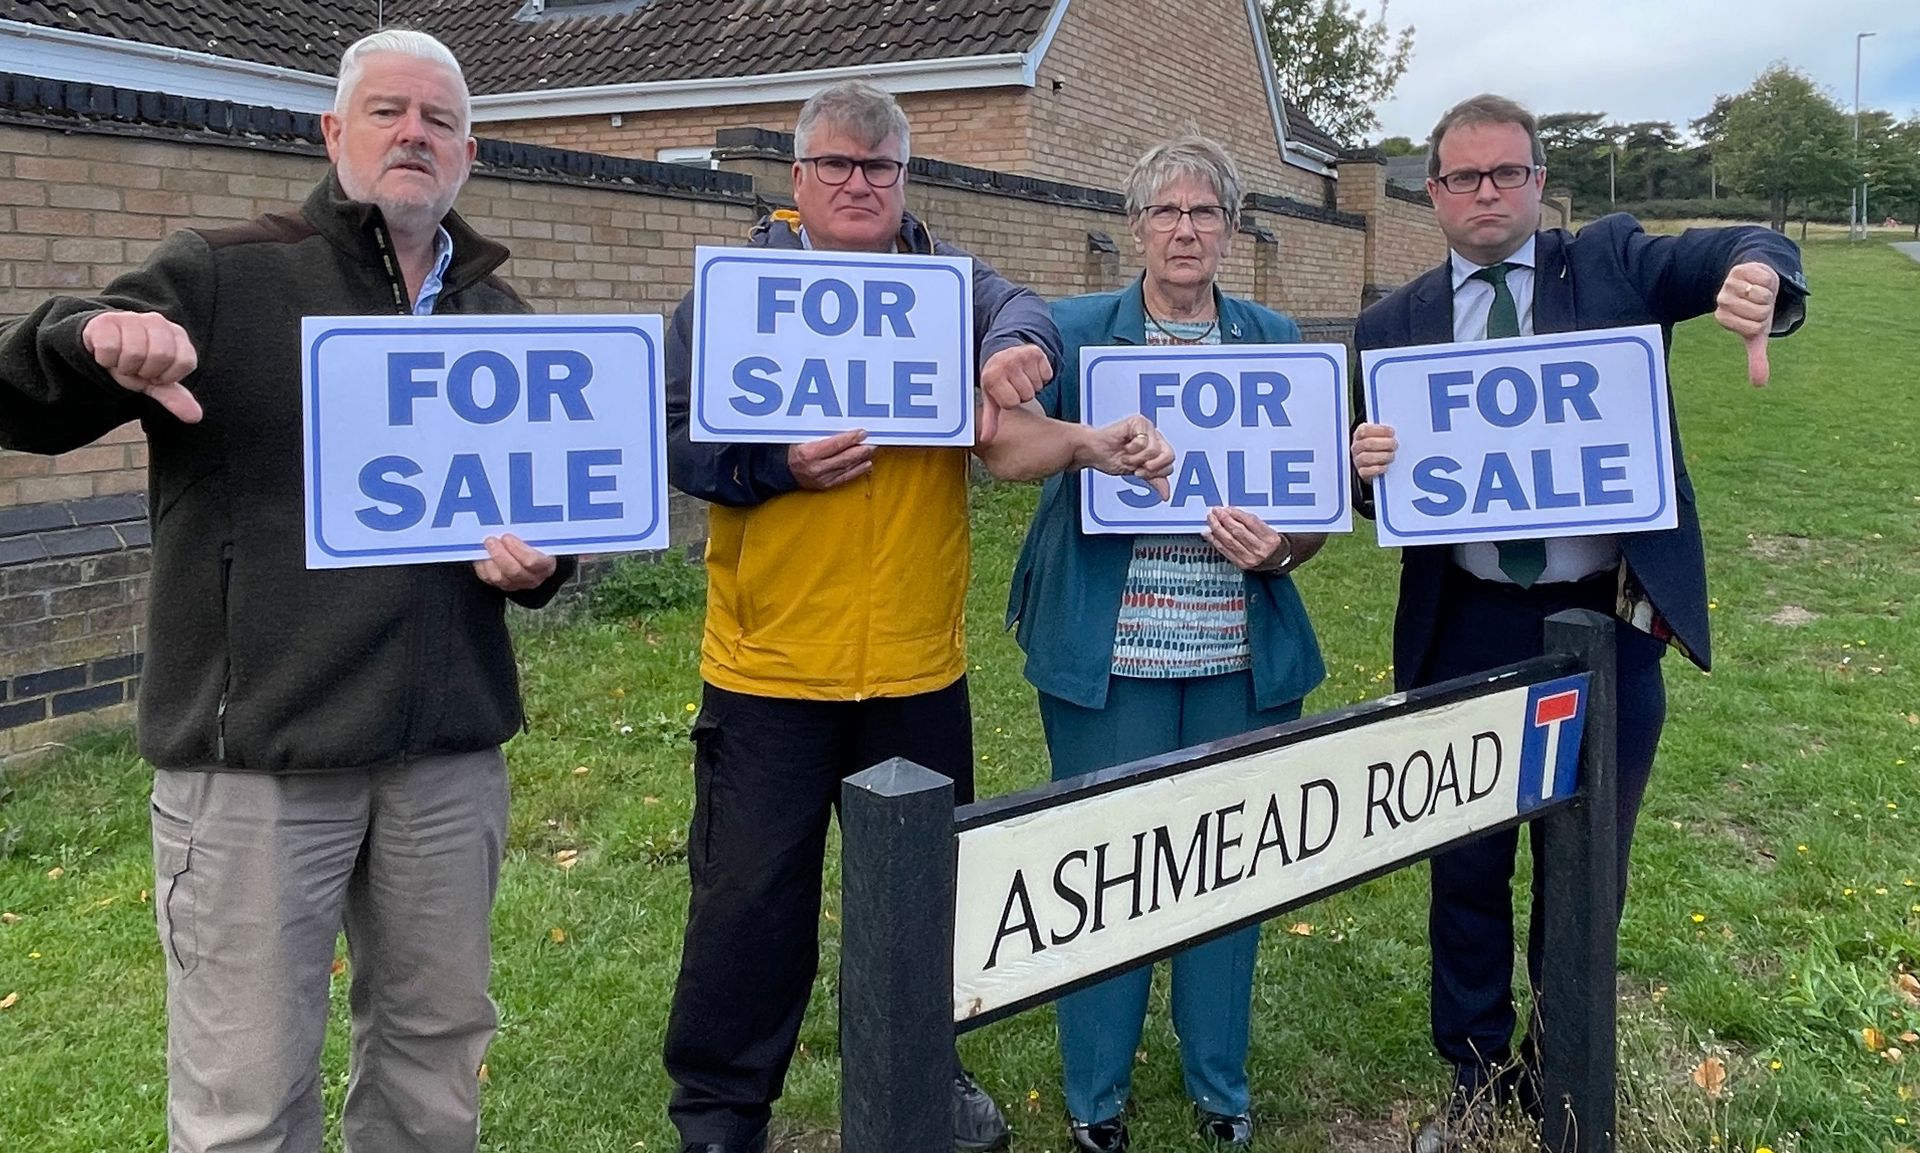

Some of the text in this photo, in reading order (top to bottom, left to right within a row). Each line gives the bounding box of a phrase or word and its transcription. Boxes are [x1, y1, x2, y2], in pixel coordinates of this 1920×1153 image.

[758, 276, 916, 338] FOR
[387, 350, 594, 426] FOR
[728, 356, 938, 419] SALE
[1139, 371, 1292, 429] FOR
[1427, 361, 1602, 433] FOR
[355, 448, 624, 531] SALE
[1411, 443, 1634, 517] SALE
[983, 731, 1503, 971] ASHMEAD ROAD
